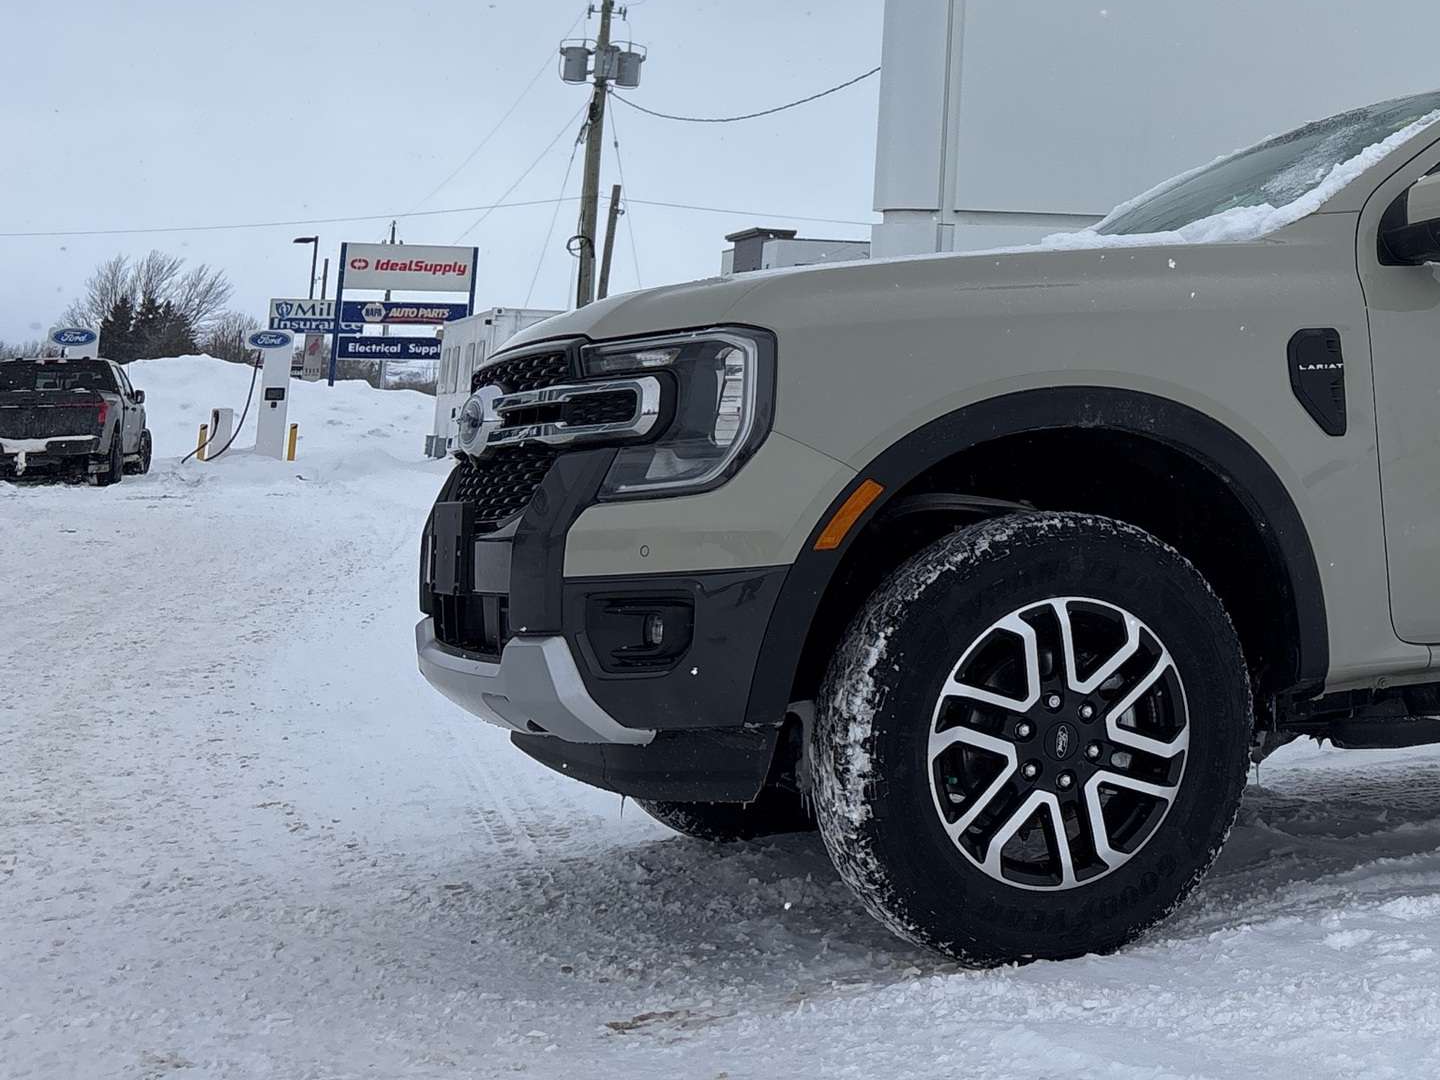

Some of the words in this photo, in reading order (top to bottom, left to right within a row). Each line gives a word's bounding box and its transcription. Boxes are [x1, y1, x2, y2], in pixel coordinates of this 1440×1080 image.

[295, 302, 332, 317] Mil
[388, 307, 418, 318] AUTO
[417, 308, 450, 319] PARTS
[60, 331, 88, 342] Ford
[257, 333, 284, 345] Ford
[347, 342, 402, 353] Electrical
[408, 343, 441, 356] Suppl
[1298, 363, 1344, 371] LARIAT
